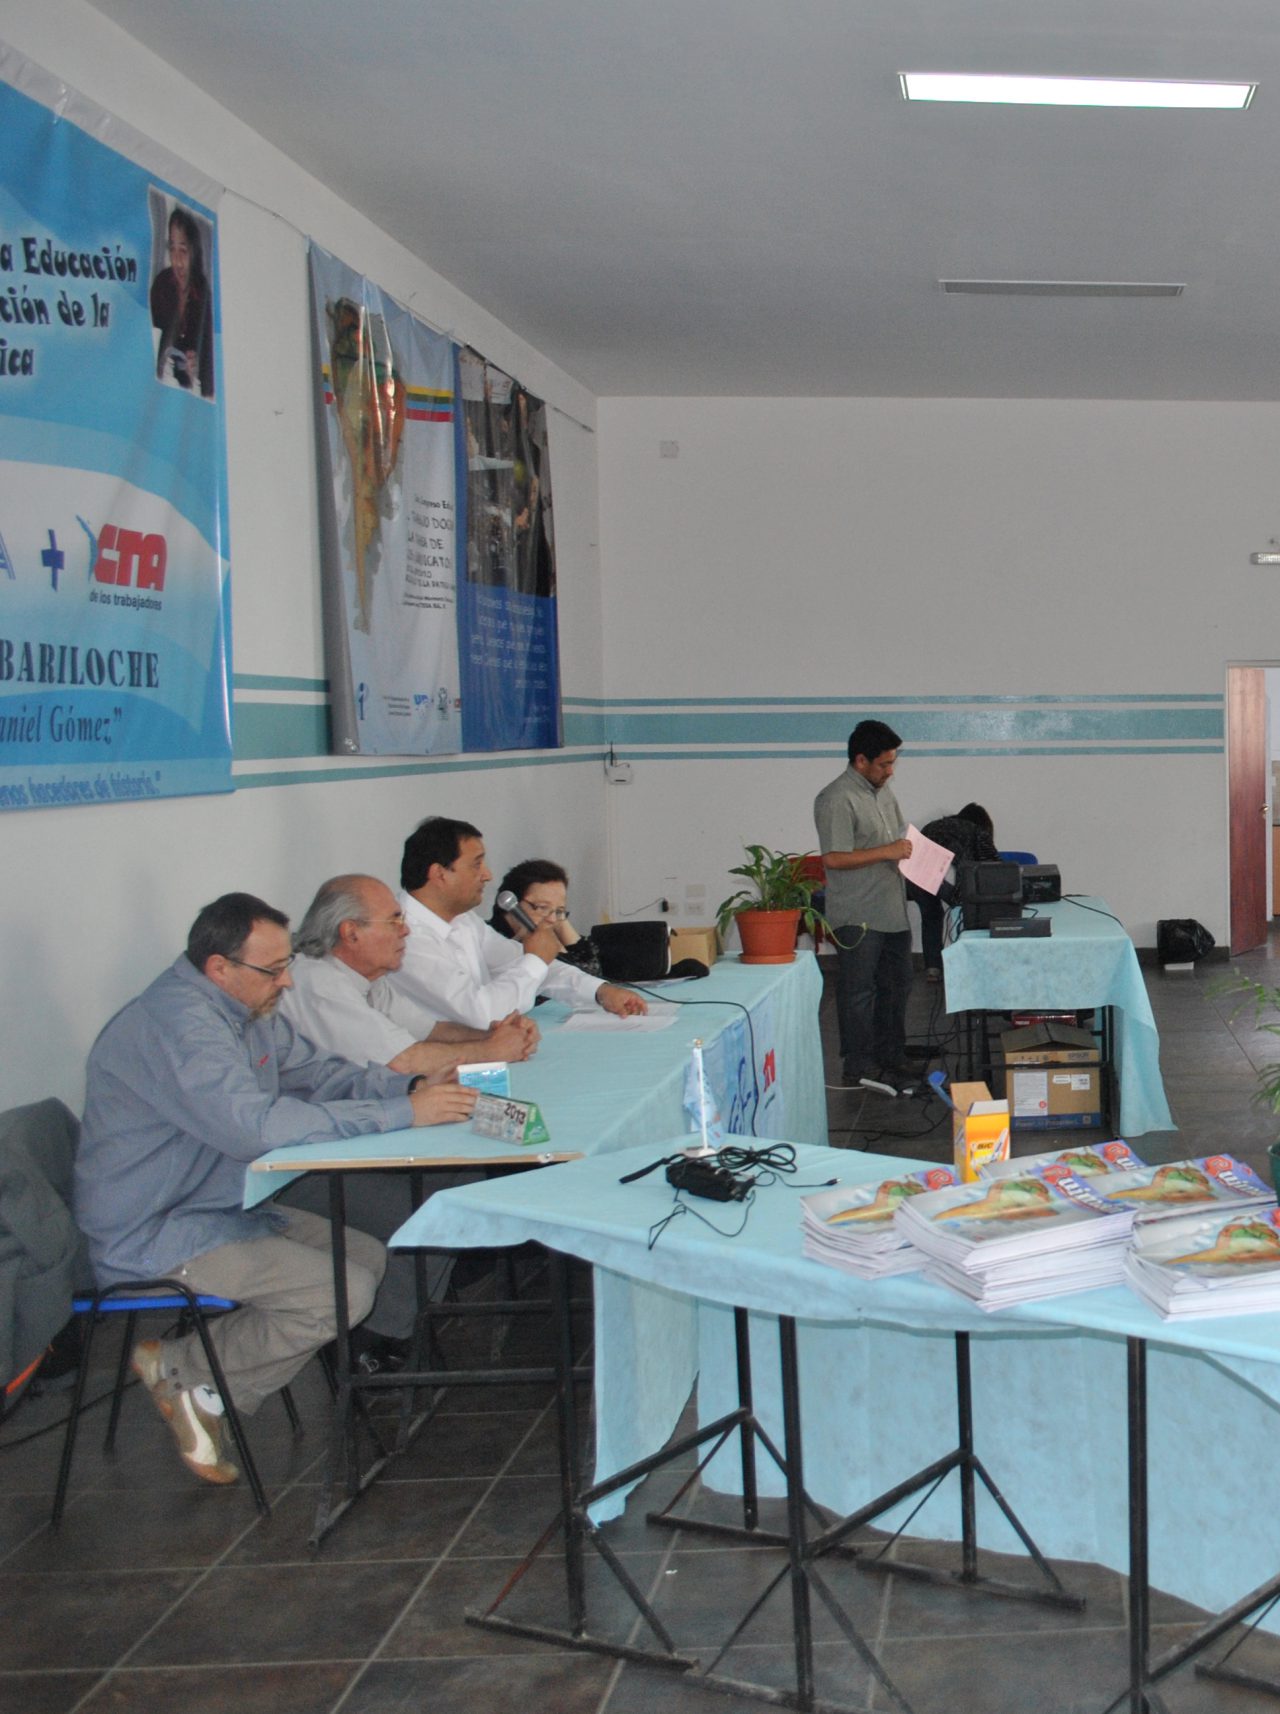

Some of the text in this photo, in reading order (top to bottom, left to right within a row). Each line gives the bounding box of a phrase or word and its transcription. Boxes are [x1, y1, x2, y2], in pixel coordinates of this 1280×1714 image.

[22, 237, 137, 282] Educación
[57, 289, 86, 327] de
[90, 292, 110, 328] la
[0, 638, 160, 689] BARILOCHE
[504, 1102, 526, 1125] 2013
